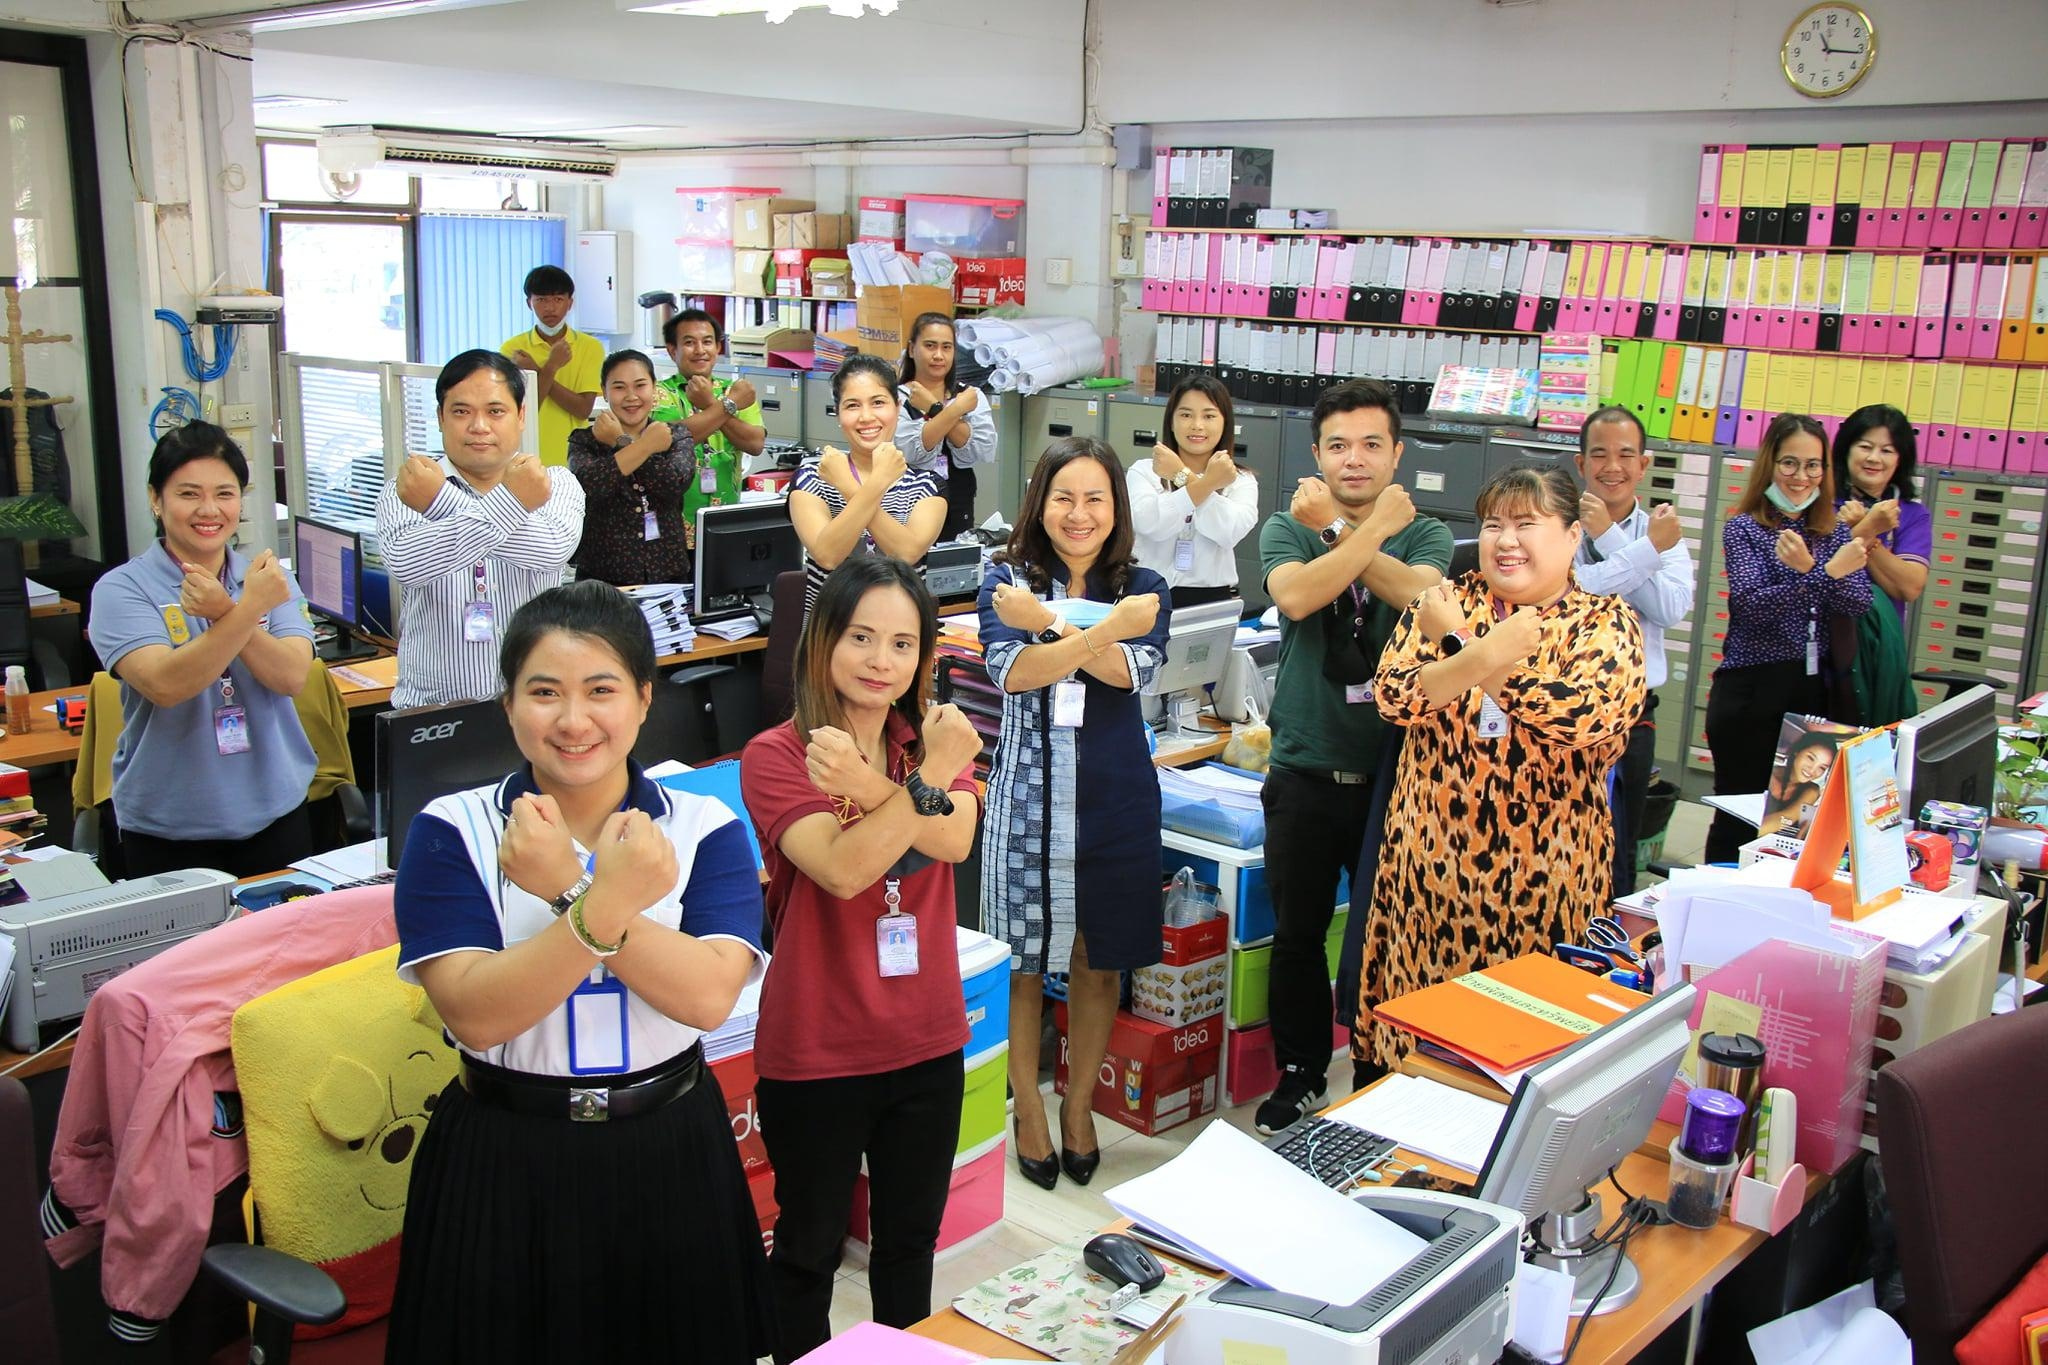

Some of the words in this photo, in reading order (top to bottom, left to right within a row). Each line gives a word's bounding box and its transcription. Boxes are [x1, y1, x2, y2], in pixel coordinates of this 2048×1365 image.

[1826, 14, 1838, 25] 12
[1846, 18, 1850, 28] 1
[1812, 20, 1820, 30] 11
[1800, 31, 1811, 41] 10
[1853, 27, 1861, 38] 2
[1793, 47, 1800, 57] 9
[1858, 43, 1864, 54] 3
[1797, 63, 1804, 73] 8
[1850, 60, 1857, 70] 4
[1810, 73, 1816, 83] 7
[1837, 71, 1844, 81] 5
[1822, 76, 1829, 87] 6
[966, 261, 986, 273] idea
[999, 275, 1025, 293] idea
[410, 720, 463, 744] acer
[1173, 1028, 1209, 1054] idea
